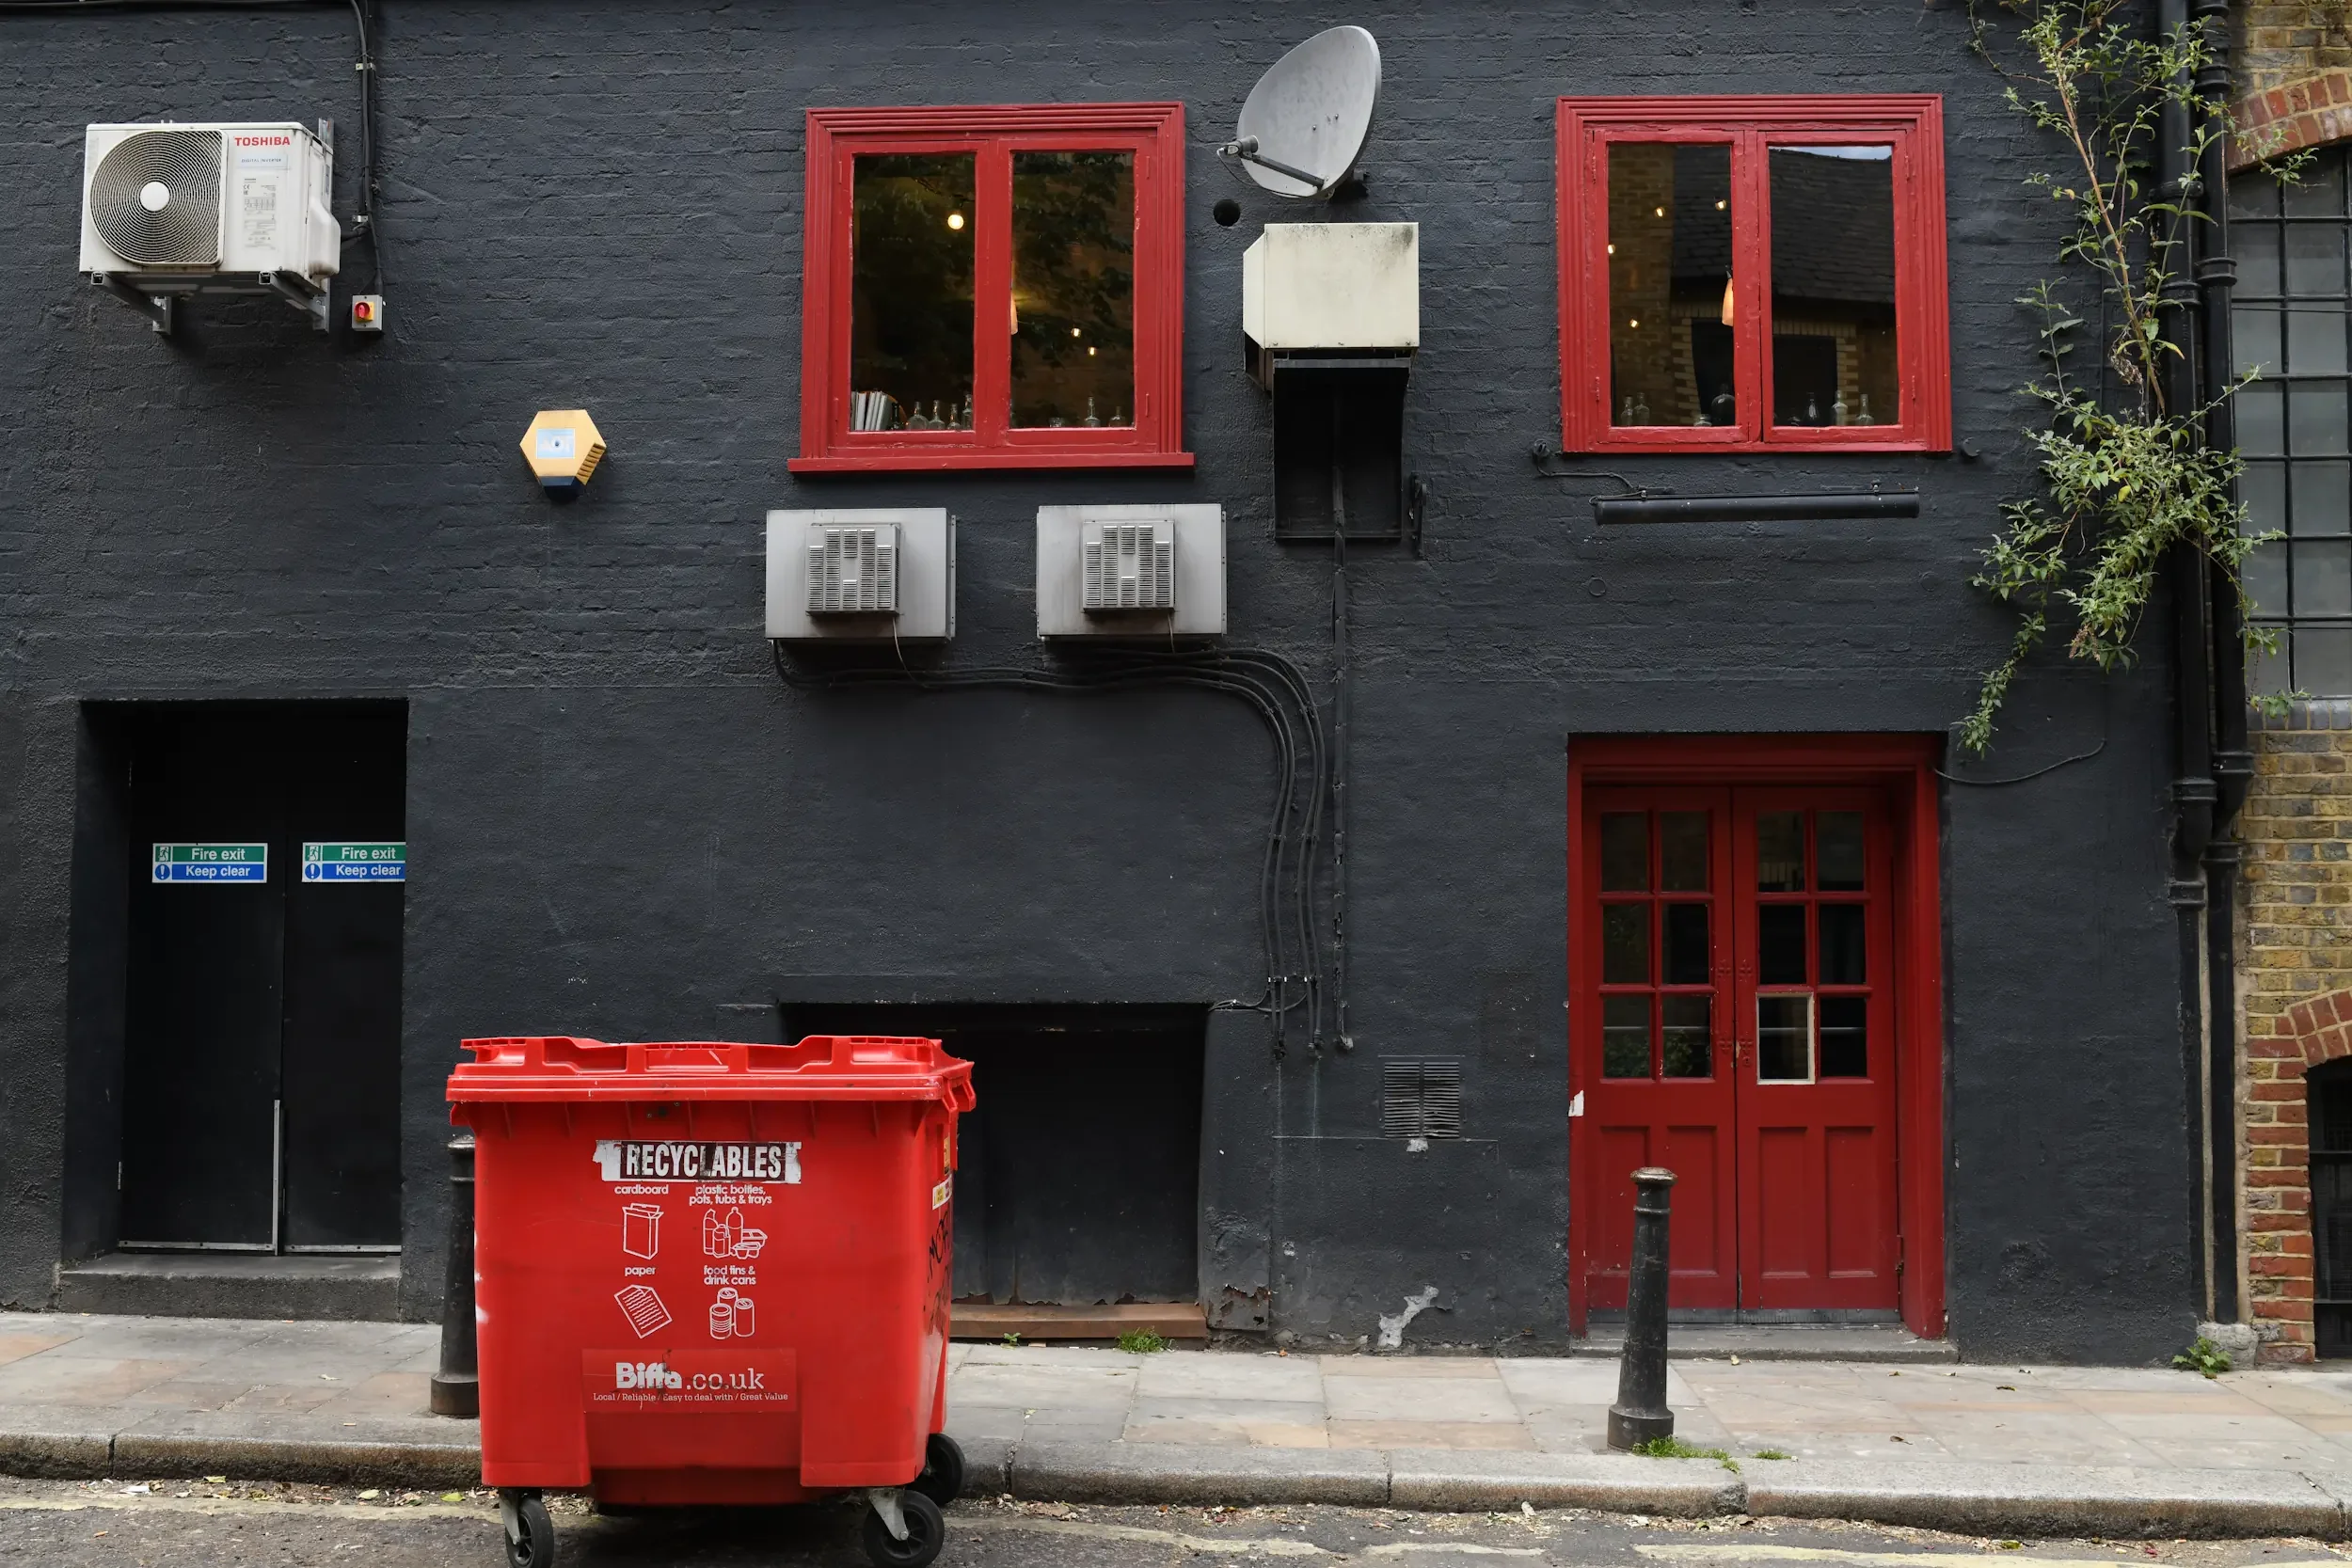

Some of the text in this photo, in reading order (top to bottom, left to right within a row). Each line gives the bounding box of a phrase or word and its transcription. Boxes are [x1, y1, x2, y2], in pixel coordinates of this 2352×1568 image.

[234, 136, 291, 147] TOSHIBA
[191, 847, 246, 861] Fire exit
[342, 847, 396, 860] Fire exit
[185, 865, 250, 879] Keep clear
[335, 864, 402, 879] Keep clear
[627, 1144, 783, 1178] RECYCLABLES
[614, 1184, 669, 1195] cardboard
[695, 1184, 767, 1196] plastic bottles,
[689, 1195, 772, 1206] pots, tubs & trays
[625, 1266, 656, 1277] paper
[704, 1265, 755, 1275] food tins &
[704, 1275, 756, 1286] drink cans
[593, 1392, 615, 1402] Local
[622, 1392, 656, 1402] Reliable
[662, 1393, 683, 1403] Easy
[684, 1393, 693, 1402] to
[693, 1392, 713, 1402] deal
[714, 1392, 734, 1402] with
[739, 1392, 763, 1402] Great
[764, 1392, 788, 1402] Value
